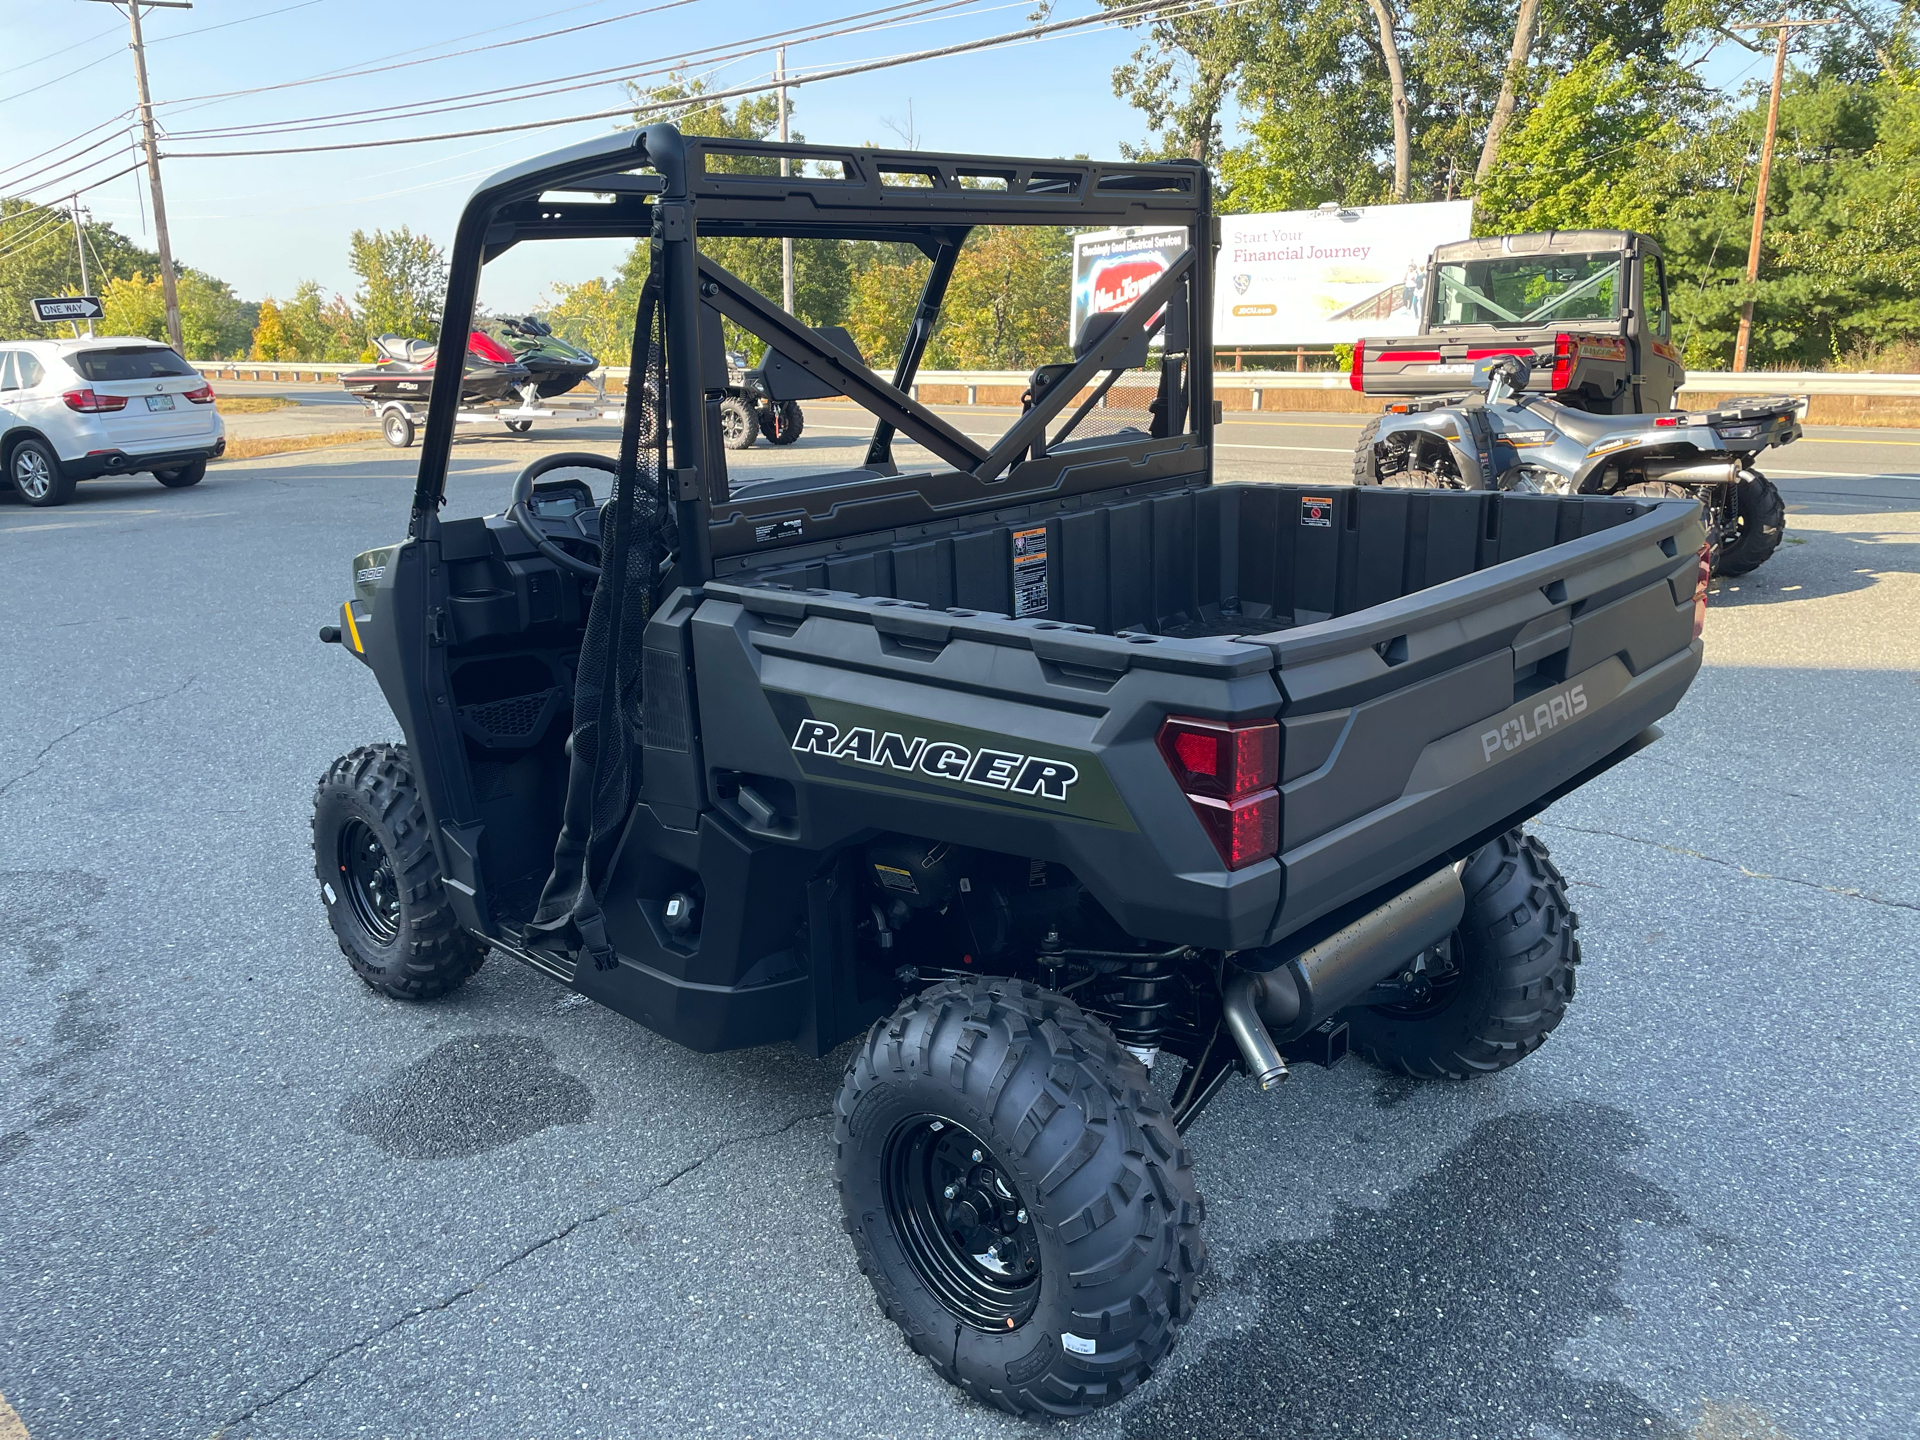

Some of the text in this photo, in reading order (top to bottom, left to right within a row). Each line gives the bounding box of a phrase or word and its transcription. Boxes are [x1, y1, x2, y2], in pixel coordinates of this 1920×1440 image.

[1111, 241, 1126, 253] Good
[1127, 237, 1154, 252] Electrical
[1154, 235, 1182, 248] Services
[1234, 230, 1303, 244] Start Your
[1233, 245, 1372, 263] Financial Journey
[43, 303, 82, 315] ONE WAY
[1582, 346, 1612, 356] RANGER
[356, 566, 386, 583] 1000
[1480, 683, 1588, 763] POLARIS
[791, 718, 1080, 802] RANGER
